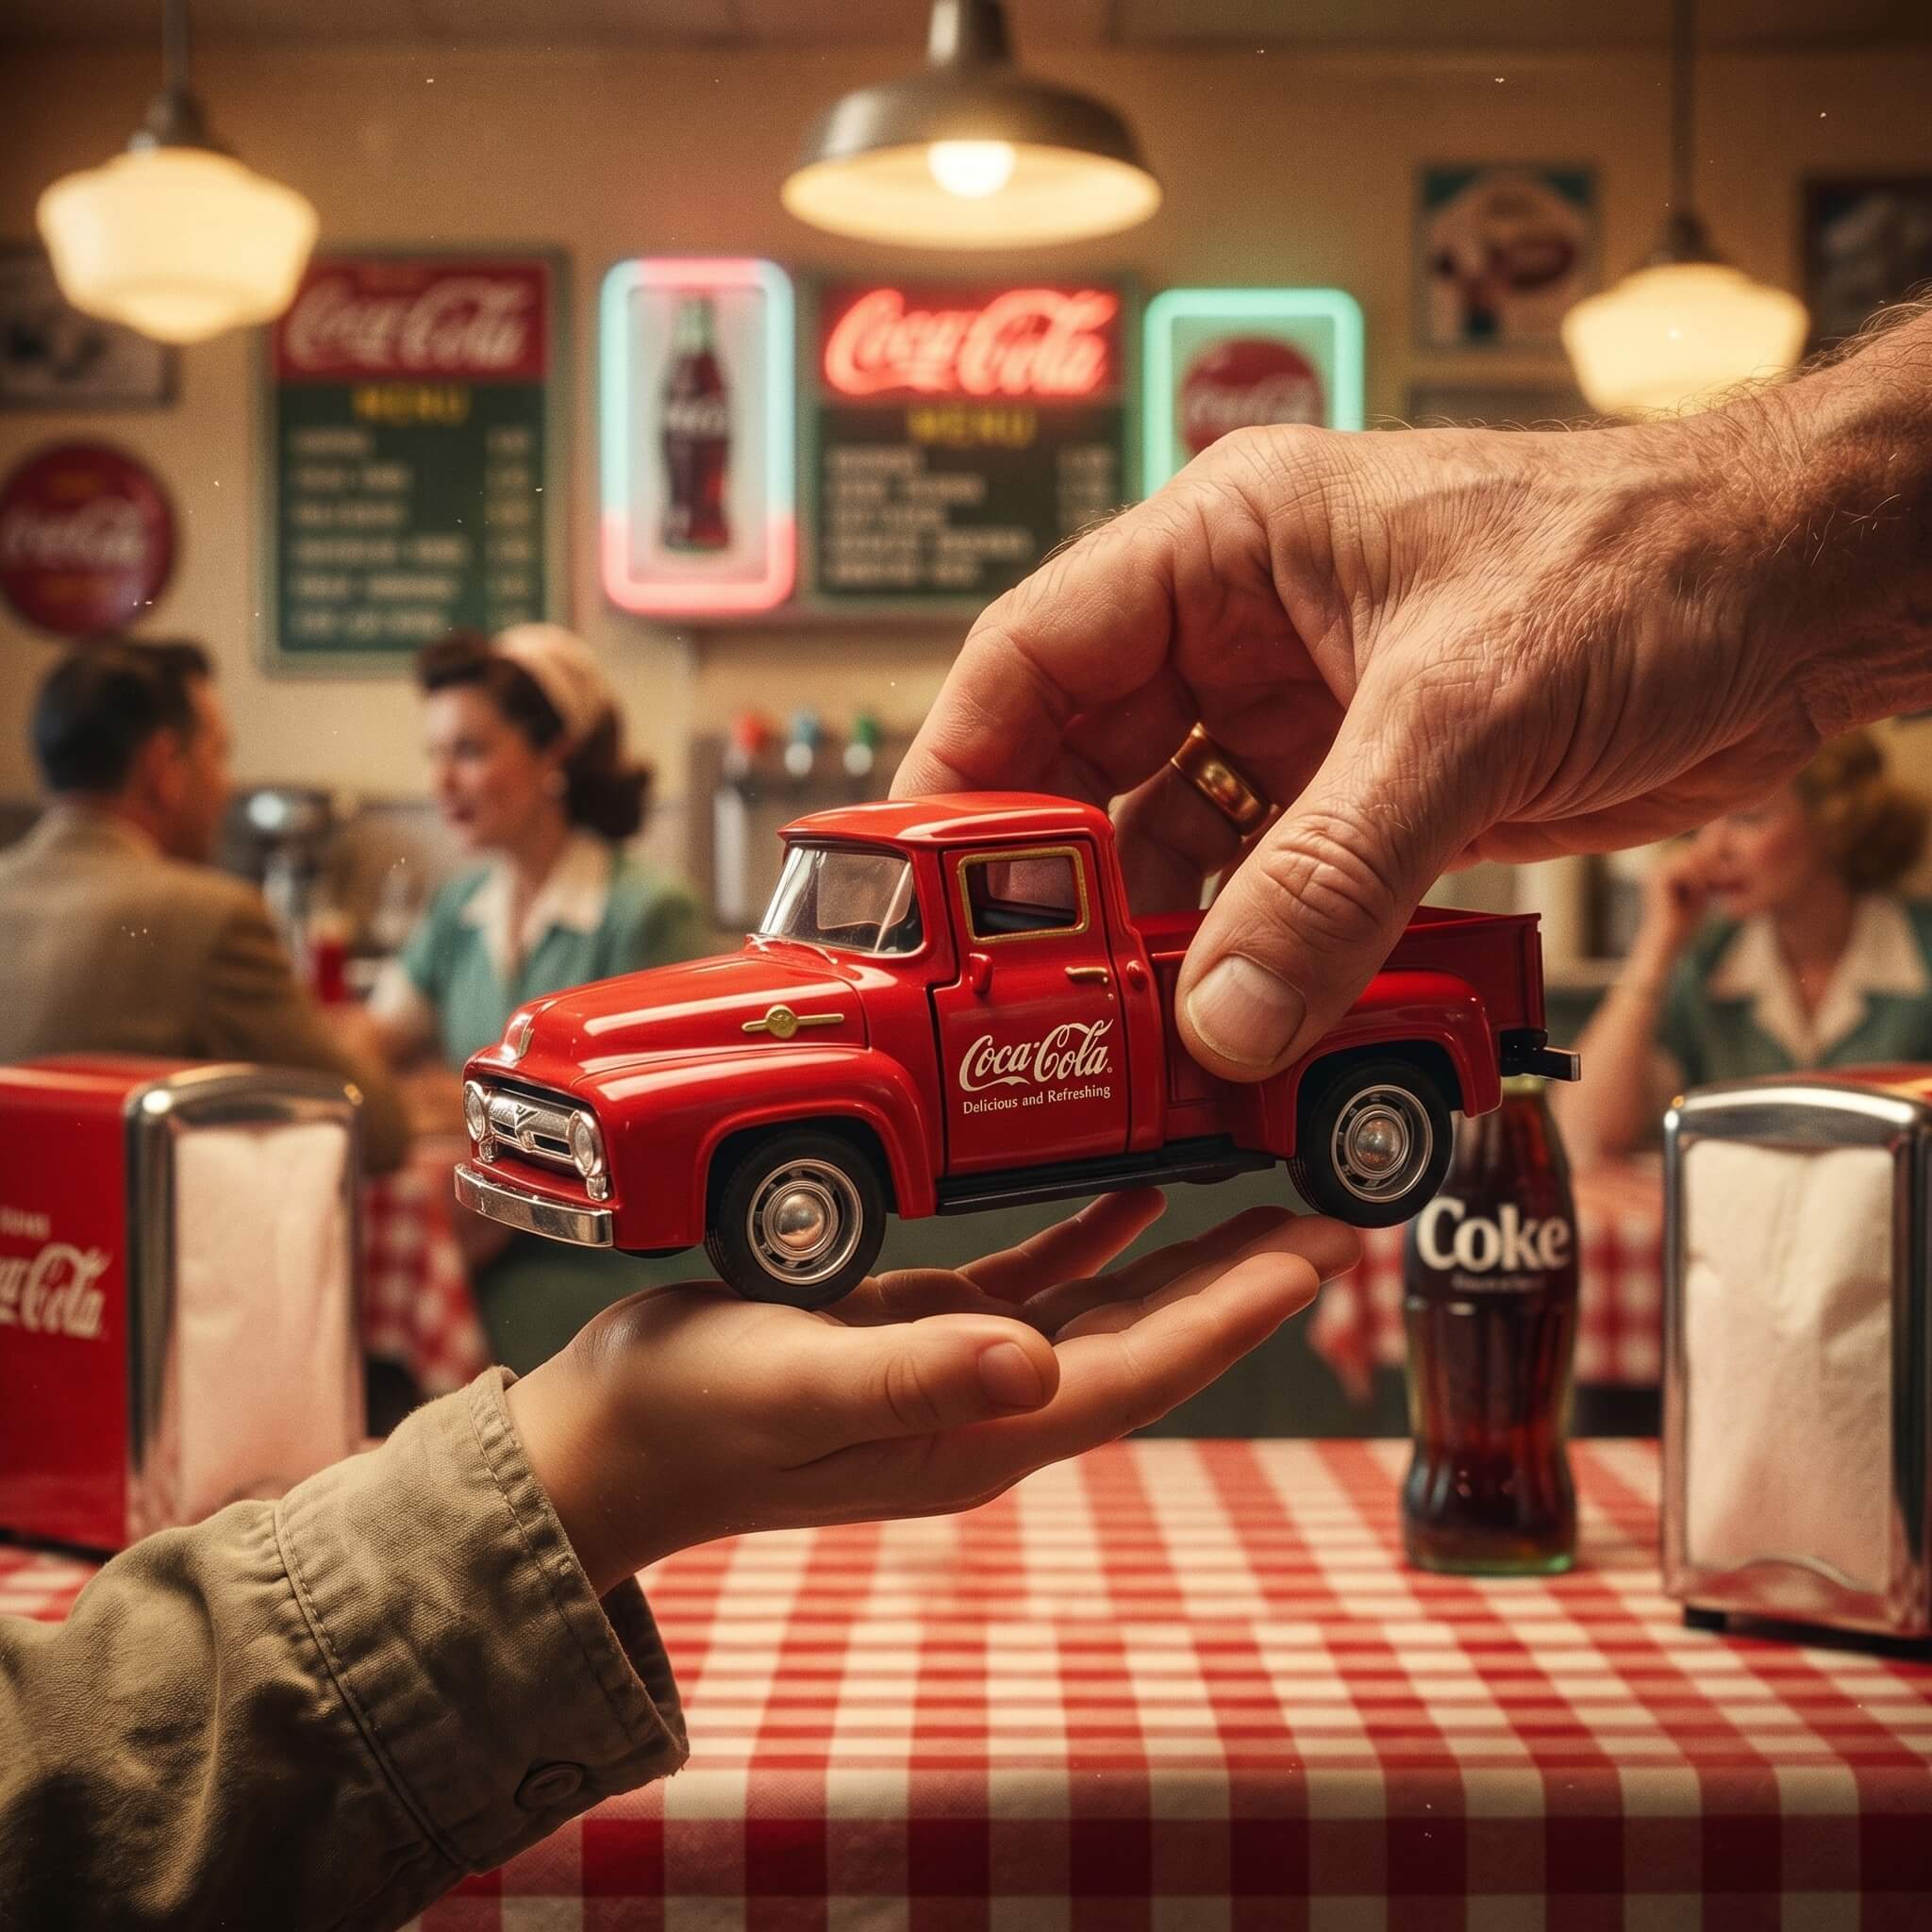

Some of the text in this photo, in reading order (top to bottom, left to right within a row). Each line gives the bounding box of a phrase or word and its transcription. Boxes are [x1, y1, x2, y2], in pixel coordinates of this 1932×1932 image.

[958, 1019, 1114, 1091] Coca-Cola
[963, 1085, 1111, 1114] Delicious and Refreshing
[1417, 1196, 1571, 1272] Coke
